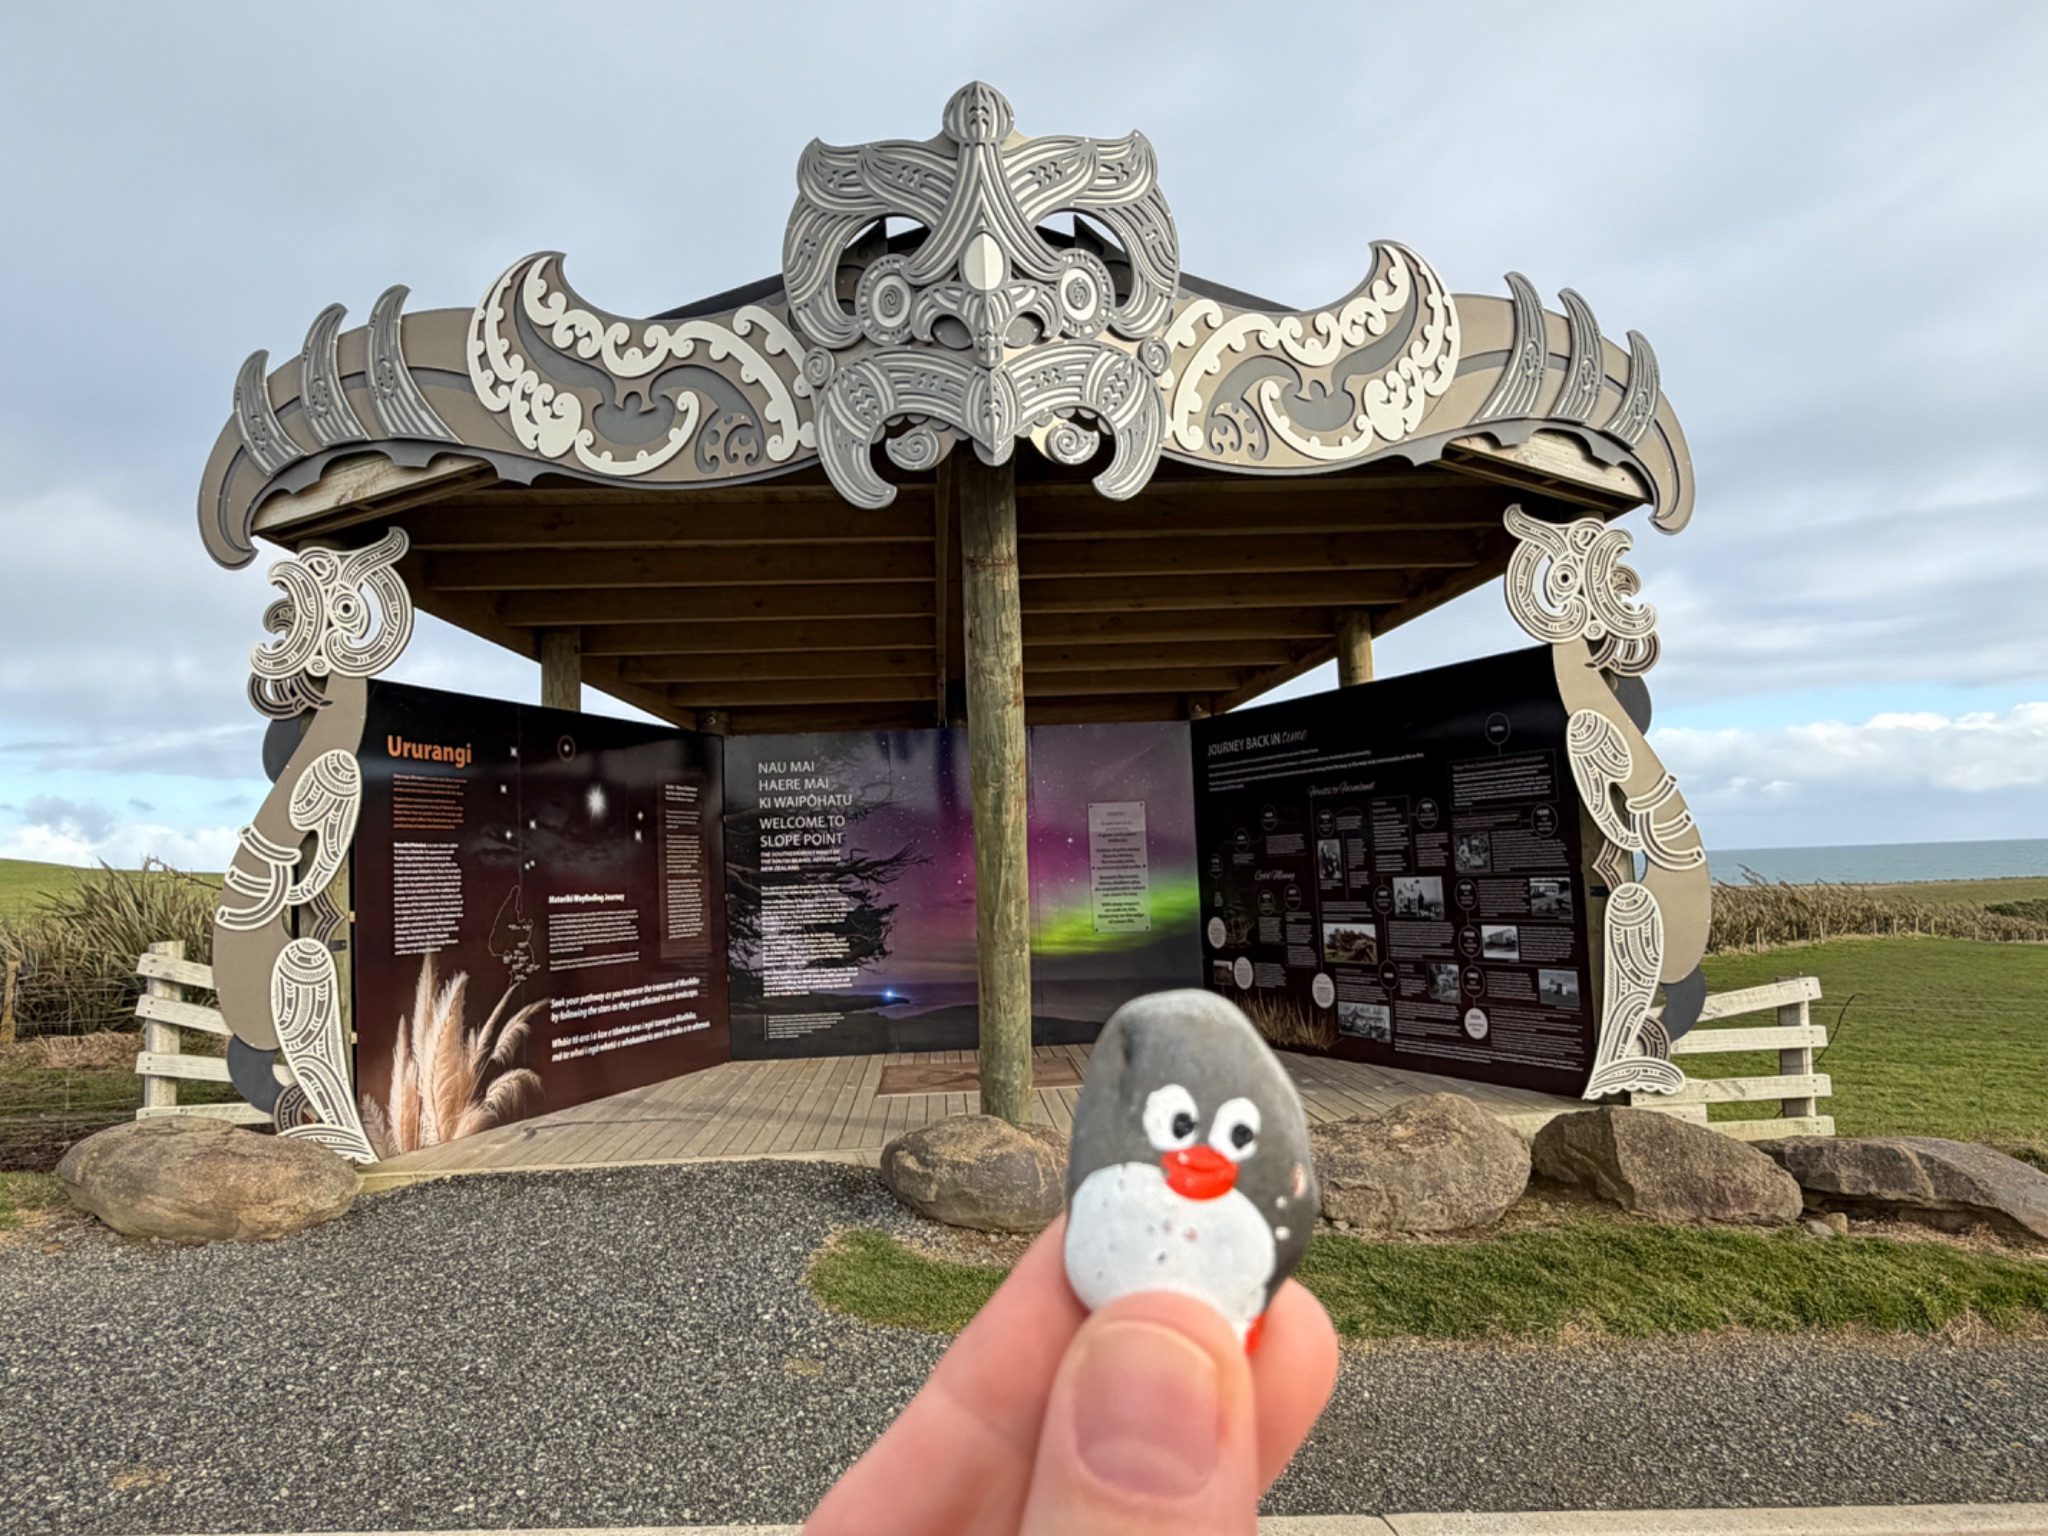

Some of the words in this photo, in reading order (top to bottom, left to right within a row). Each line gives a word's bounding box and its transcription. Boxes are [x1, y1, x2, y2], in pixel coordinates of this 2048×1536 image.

[387, 734, 472, 769] Ururangi
[1208, 738, 1244, 756] JOURNEY
[1246, 735, 1270, 750] BACK
[1270, 733, 1281, 745] IN
[758, 762, 787, 774] NAU
[790, 760, 815, 773] MAI
[759, 778, 800, 791] HAERE
[804, 777, 829, 790] MAI
[759, 797, 771, 809] KI
[759, 816, 827, 830] WELCOME
[827, 815, 846, 827] TO
[760, 833, 800, 848] SLOPE
[803, 832, 844, 846] POINT
